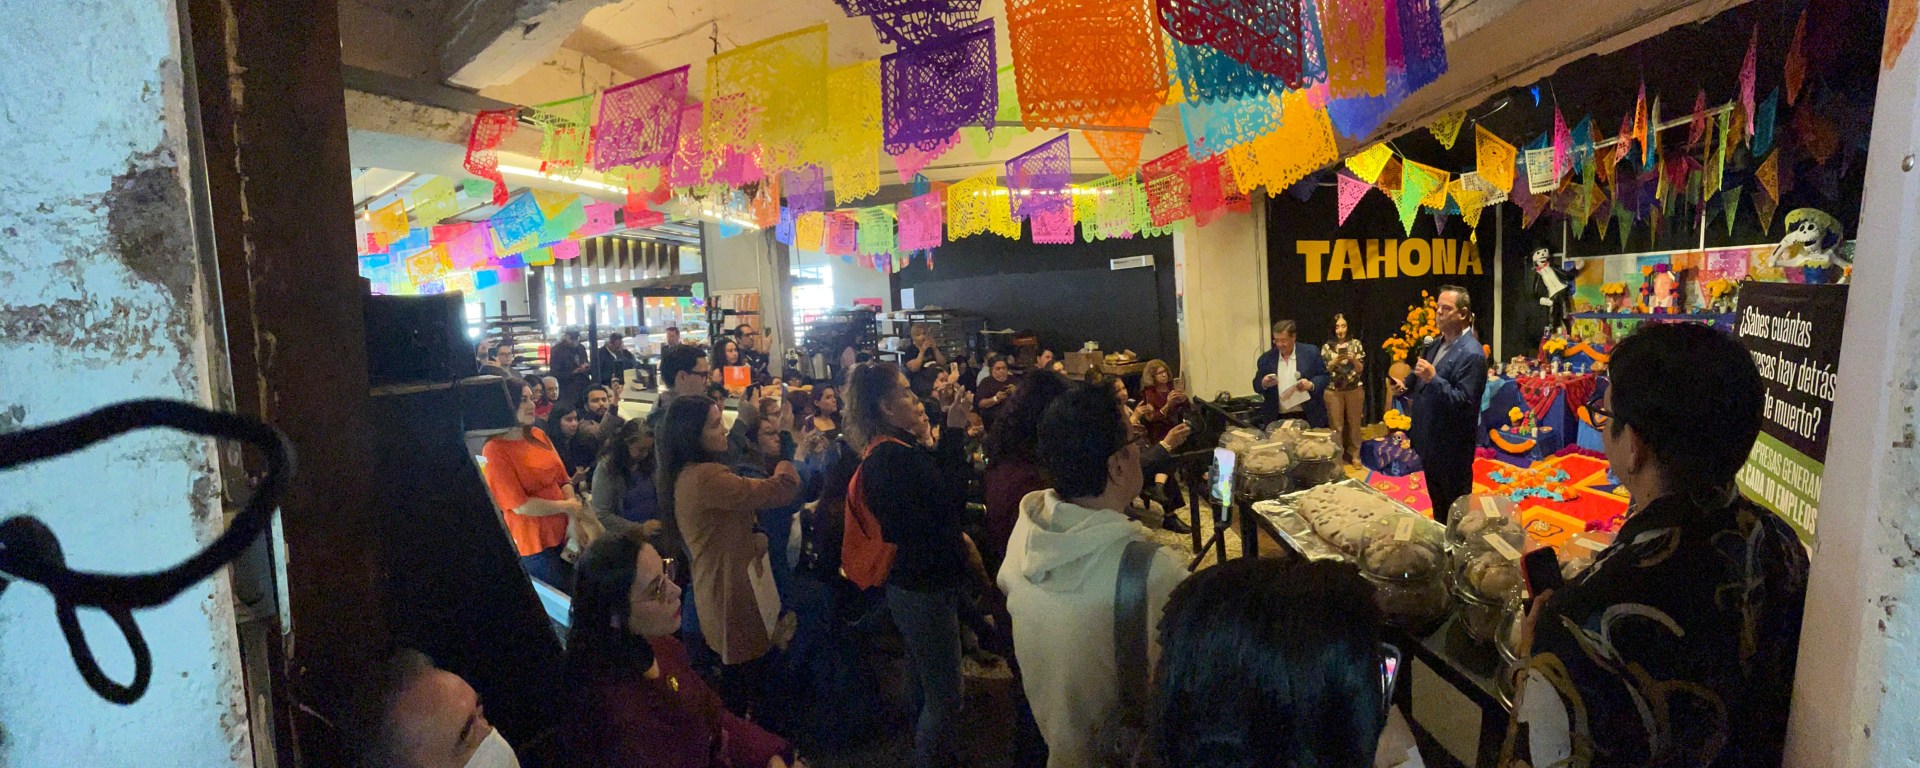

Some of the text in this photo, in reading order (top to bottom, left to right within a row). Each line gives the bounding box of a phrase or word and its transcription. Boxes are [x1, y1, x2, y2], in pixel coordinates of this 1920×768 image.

[1296, 237, 1483, 283] TAHONA
[1739, 305, 1812, 348] ¿Sabes cuántas
[1750, 350, 1837, 402] resas hay detrás
[1774, 399, 1822, 441] muerto?
[1745, 464, 1765, 497] CADA
[1765, 477, 1776, 503] 10
[1775, 483, 1818, 535] EMPLEOS
[1782, 457, 1822, 502] GENERAN
